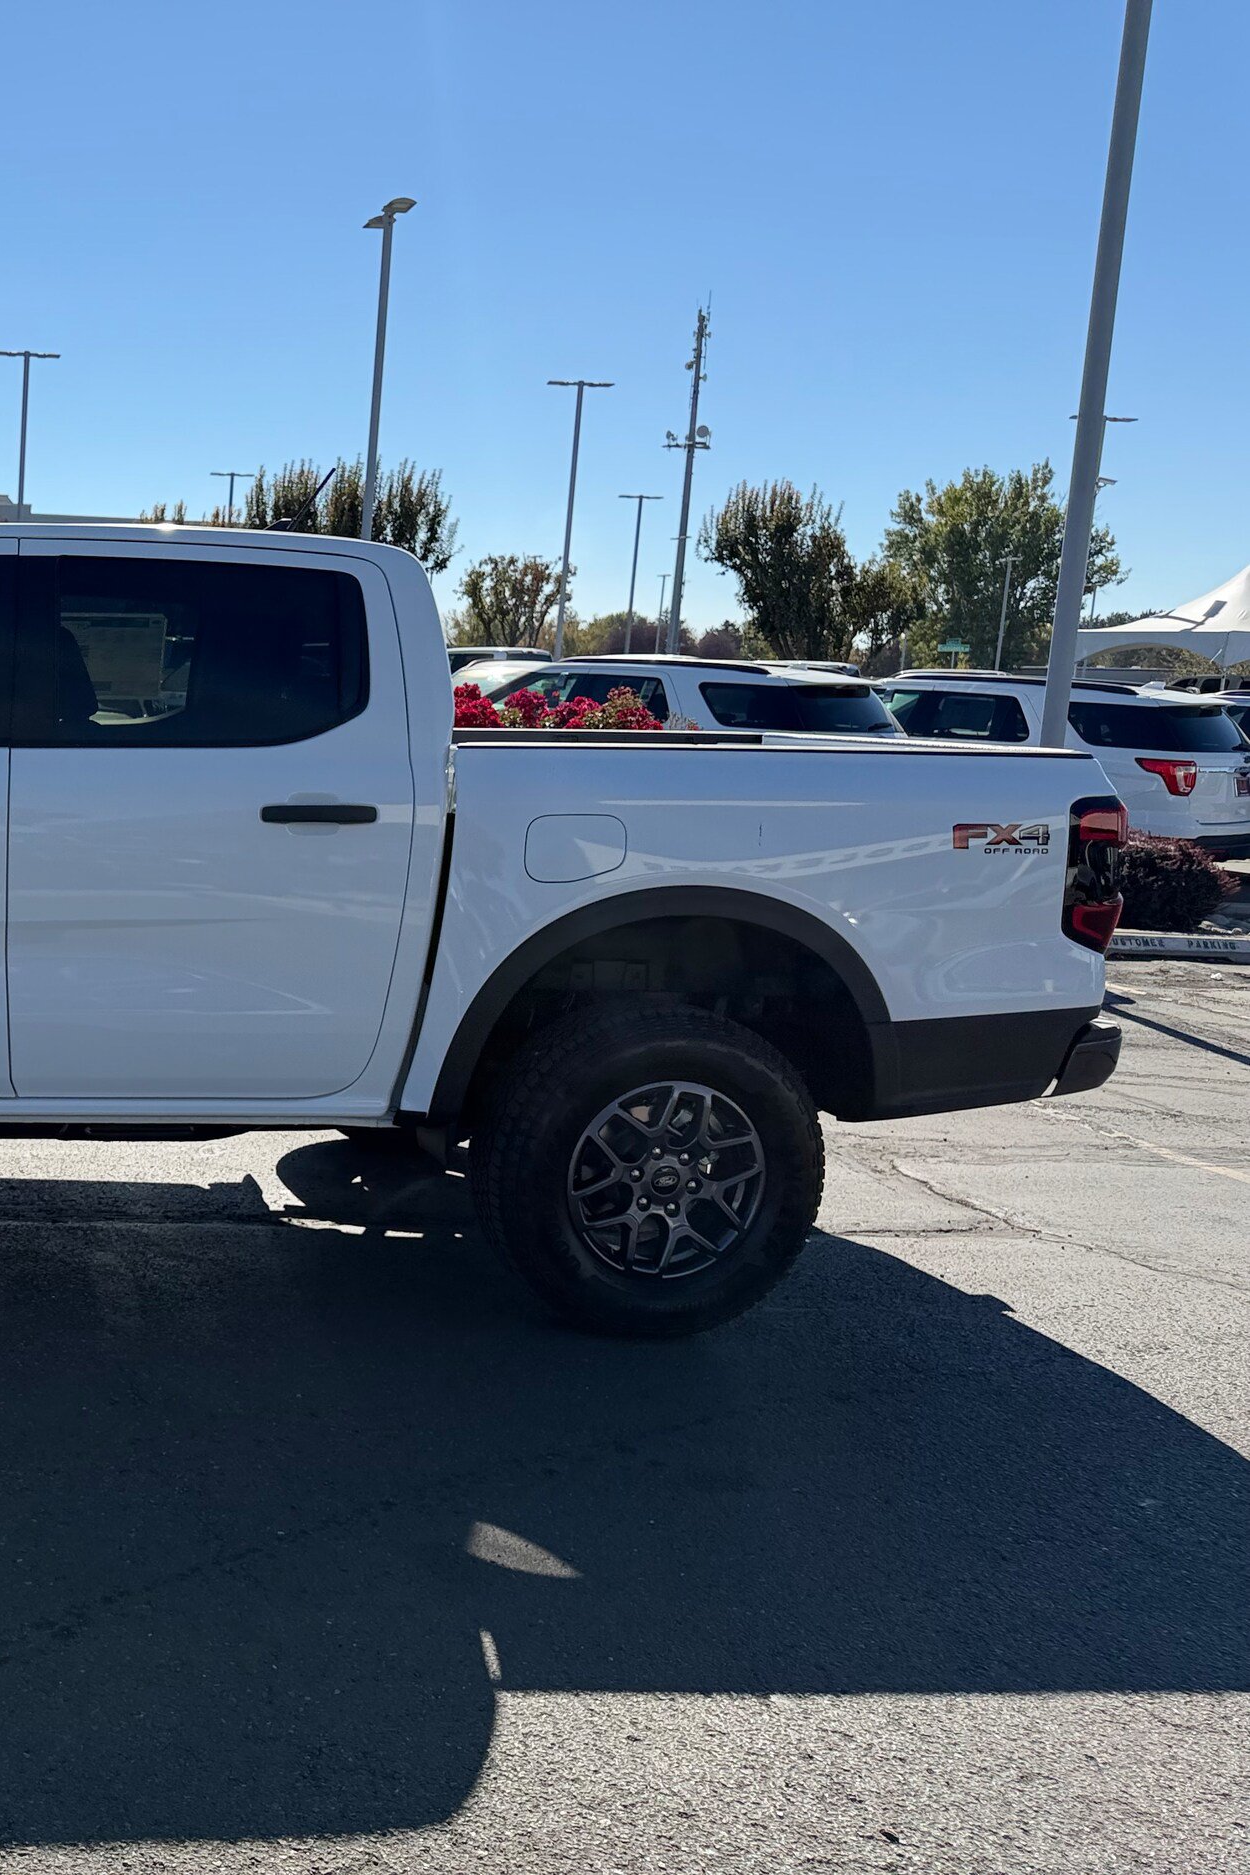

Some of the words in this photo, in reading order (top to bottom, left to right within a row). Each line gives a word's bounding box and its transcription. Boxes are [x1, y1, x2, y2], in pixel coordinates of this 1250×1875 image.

[953, 823, 1050, 849] FX4
[984, 847, 1010, 855] OFF
[1014, 847, 1049, 855] ROAD
[1112, 938, 1166, 949] USTOMER
[1187, 939, 1237, 951] PARKING
